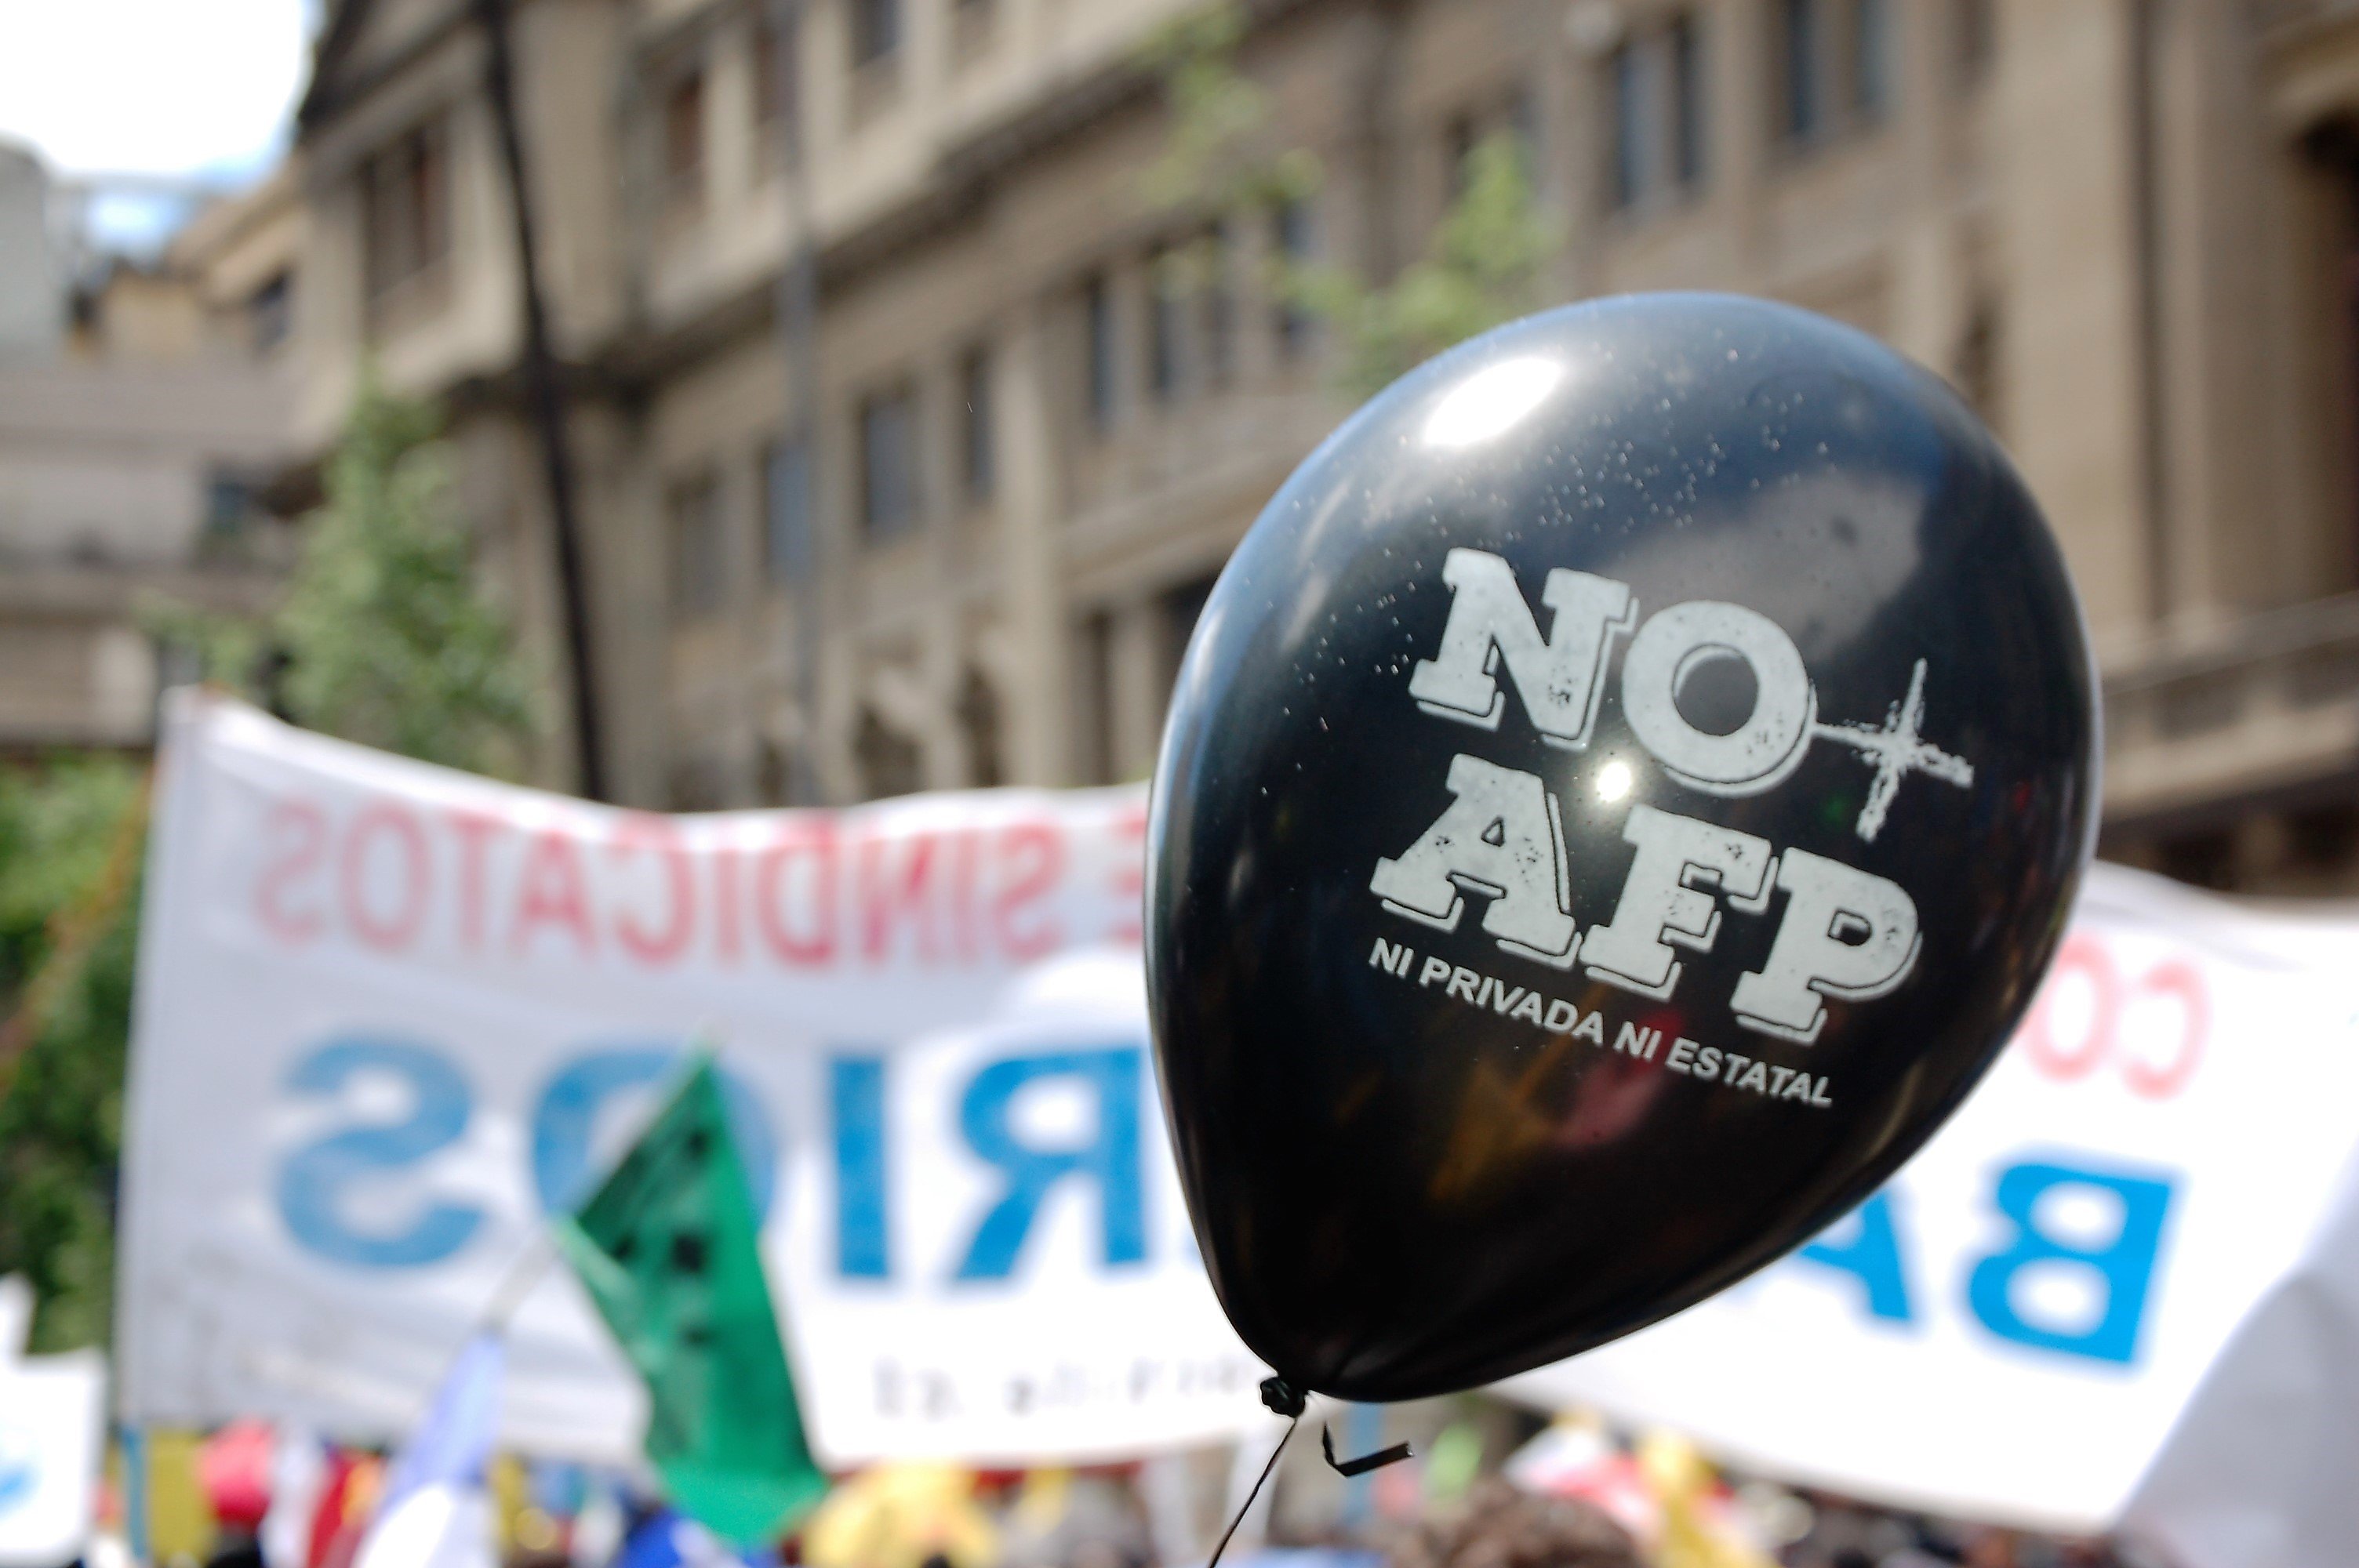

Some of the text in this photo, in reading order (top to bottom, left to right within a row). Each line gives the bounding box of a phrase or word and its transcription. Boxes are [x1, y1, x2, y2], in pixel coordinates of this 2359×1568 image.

[1369, 753, 1924, 1046] AFP
[1368, 937, 1833, 1108] NI PRIVADA NI ESTATAL
